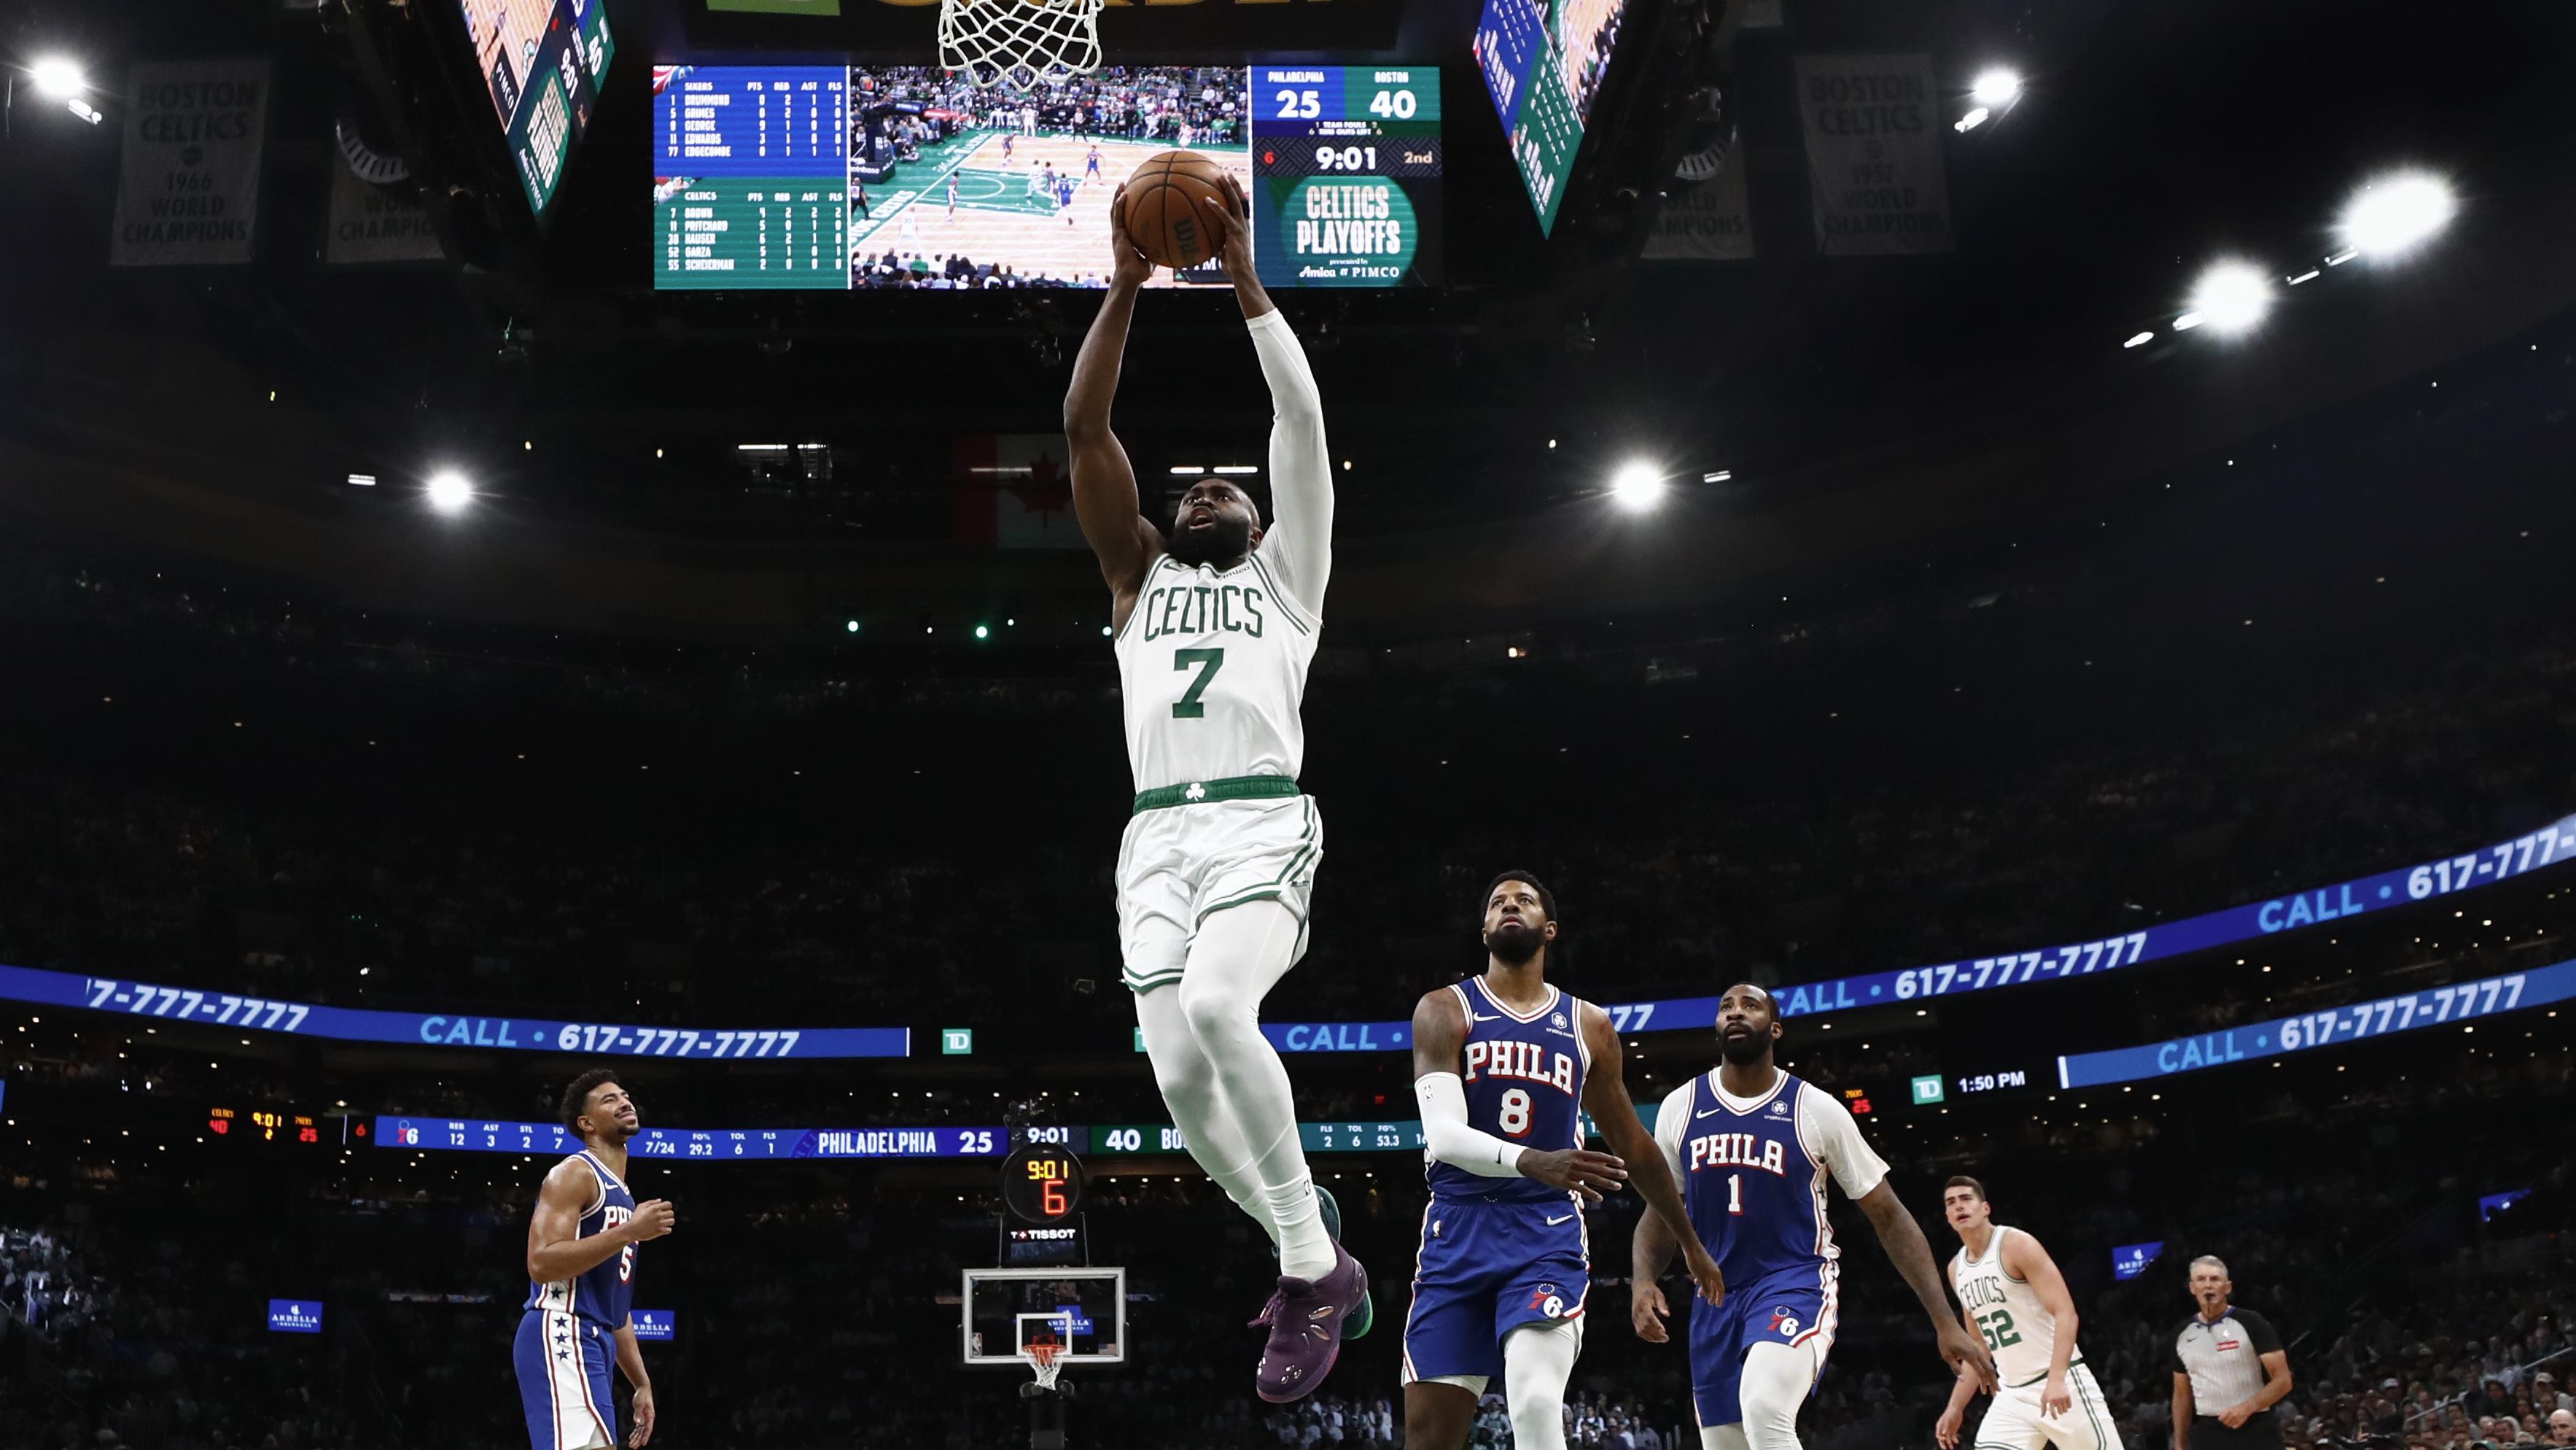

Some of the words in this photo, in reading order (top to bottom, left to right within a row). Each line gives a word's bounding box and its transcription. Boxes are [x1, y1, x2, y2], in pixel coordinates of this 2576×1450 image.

[496, 62, 515, 109] PIMCO
[685, 82, 713, 91] SIXERS
[747, 82, 763, 91] PTS
[801, 82, 817, 91] AST
[828, 82, 842, 91] FLS
[1268, 71, 1325, 83] PHILADELPHIA
[1374, 71, 1409, 83] BOSTON
[1812, 74, 1925, 102] BOSTON
[139, 82, 258, 109] BOSTON
[785, 94, 791, 106] 2
[812, 94, 817, 106] 1
[1276, 90, 1320, 119] 25
[1369, 90, 1417, 119] 40
[785, 107, 791, 119] 2
[1818, 106, 1923, 136] CELTICS
[140, 113, 248, 141] CELTICS
[786, 120, 790, 131] 1
[786, 133, 790, 144] 1
[668, 146, 678, 157] 77
[786, 146, 790, 157] 1
[812, 146, 817, 157] 1
[1263, 151, 1275, 164] 6
[1315, 147, 1377, 170] 9:01
[1404, 151, 1432, 164] 2nd
[167, 172, 212, 192] 1966
[152, 195, 225, 217] WORLD
[685, 192, 717, 201] CELTICS
[747, 193, 763, 202] PTS
[801, 193, 818, 202] AST
[829, 193, 843, 202] FLS
[1306, 185, 1390, 220] CELTICS
[1845, 187, 1916, 209] WORLD
[123, 220, 246, 244] CHAMPIONS
[812, 220, 817, 231] 1
[1823, 212, 1944, 234] CHAMPIONS
[685, 233, 716, 244] HAUSER
[812, 233, 817, 244] 1
[1296, 220, 1401, 255] PLAYOFFS
[787, 247, 791, 257] 1
[1299, 265, 1336, 278] Amica
[1353, 267, 1399, 278] PIMCO
[1145, 585, 1263, 642] CELTICS
[1172, 648, 1224, 718] 7
[2259, 885, 2364, 934] CALL
[2408, 824, 2576, 899] 617-777-
[1896, 931, 2148, 1000] 617-777-7777
[86, 977, 309, 1031] 7-777-7777
[2157, 1031, 2244, 1074] CALL
[2280, 974, 2526, 1051] 617-777-7777
[420, 1017, 518, 1047] CALL
[558, 1024, 801, 1058] 617-777-7777
[945, 1033, 969, 1050] TD
[1286, 1025, 1377, 1050] CALL
[1465, 1041, 1574, 1096] PHILA
[1915, 1079, 1939, 1098] TD
[1959, 1077, 1994, 1093] 1:50
[1999, 1071, 2026, 1088] PM
[1499, 1088, 1533, 1136] 8
[1852, 1098, 1872, 1114] 25
[209, 1120, 228, 1134] 40
[253, 1112, 282, 1128] 9:01
[355, 1123, 366, 1137] 6
[449, 1123, 465, 1131] REB
[483, 1124, 499, 1132] AST
[520, 1125, 533, 1133] STL
[265, 1128, 273, 1140] 2
[299, 1128, 318, 1142] 25
[450, 1133, 465, 1146] 12
[487, 1135, 495, 1147] 3
[523, 1136, 531, 1149] 2
[555, 1138, 563, 1149] 7
[645, 1141, 674, 1154] 7/24
[689, 1144, 712, 1155] 29.2
[735, 1144, 742, 1155] 6
[768, 1143, 774, 1154] 1
[818, 1132, 936, 1154] PHILADELPHIA
[959, 1131, 993, 1153] 25
[1027, 1128, 1068, 1144] 9:01
[1105, 1129, 1141, 1151] 40
[1324, 1136, 1332, 1147] 2
[1353, 1136, 1361, 1147] 6
[1377, 1136, 1399, 1147] 53.3
[1690, 1133, 1785, 1176] PHILA
[1027, 1160, 1068, 1179] 9:01
[1043, 1179, 1066, 1215] 6
[1728, 1174, 1742, 1214] 1
[1028, 1229, 1075, 1239] TISSOT
[620, 1245, 634, 1283] 5
[1959, 1276, 2007, 1311] CELTICS
[1528, 1292, 1563, 1318] 76
[1767, 1314, 1799, 1336] 76
[1976, 1309, 2023, 1351] 52
